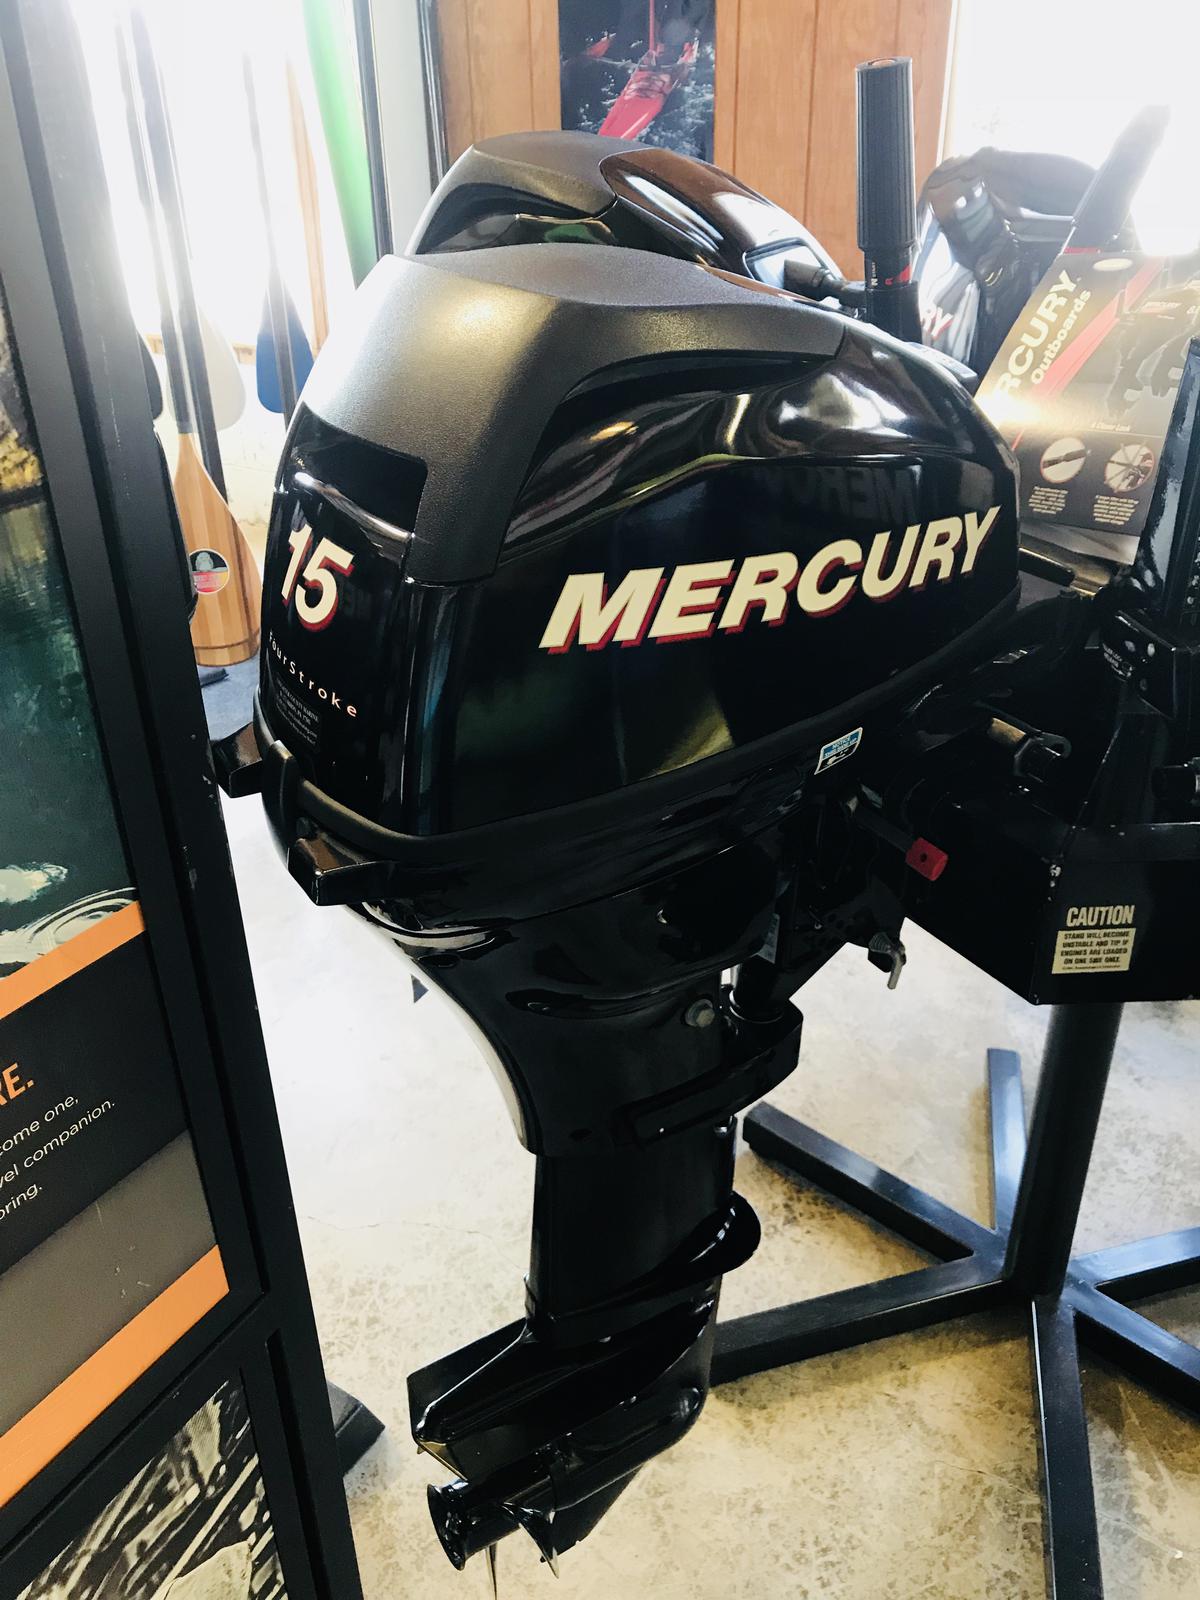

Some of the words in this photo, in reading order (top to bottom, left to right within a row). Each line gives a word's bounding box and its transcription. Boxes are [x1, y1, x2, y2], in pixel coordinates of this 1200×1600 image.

[1031, 290, 1091, 384] Outboards
[281, 523, 355, 633] 15
[539, 505, 1001, 654] MERCURY
[269, 631, 358, 718] FourStroke
[1066, 905, 1135, 927] CAUTION
[1060, 949, 1087, 957] ENGINES
[24, 1100, 115, 1168] companion.
[44, 1094, 79, 1122] one,
[0, 1183, 42, 1220] oring.
